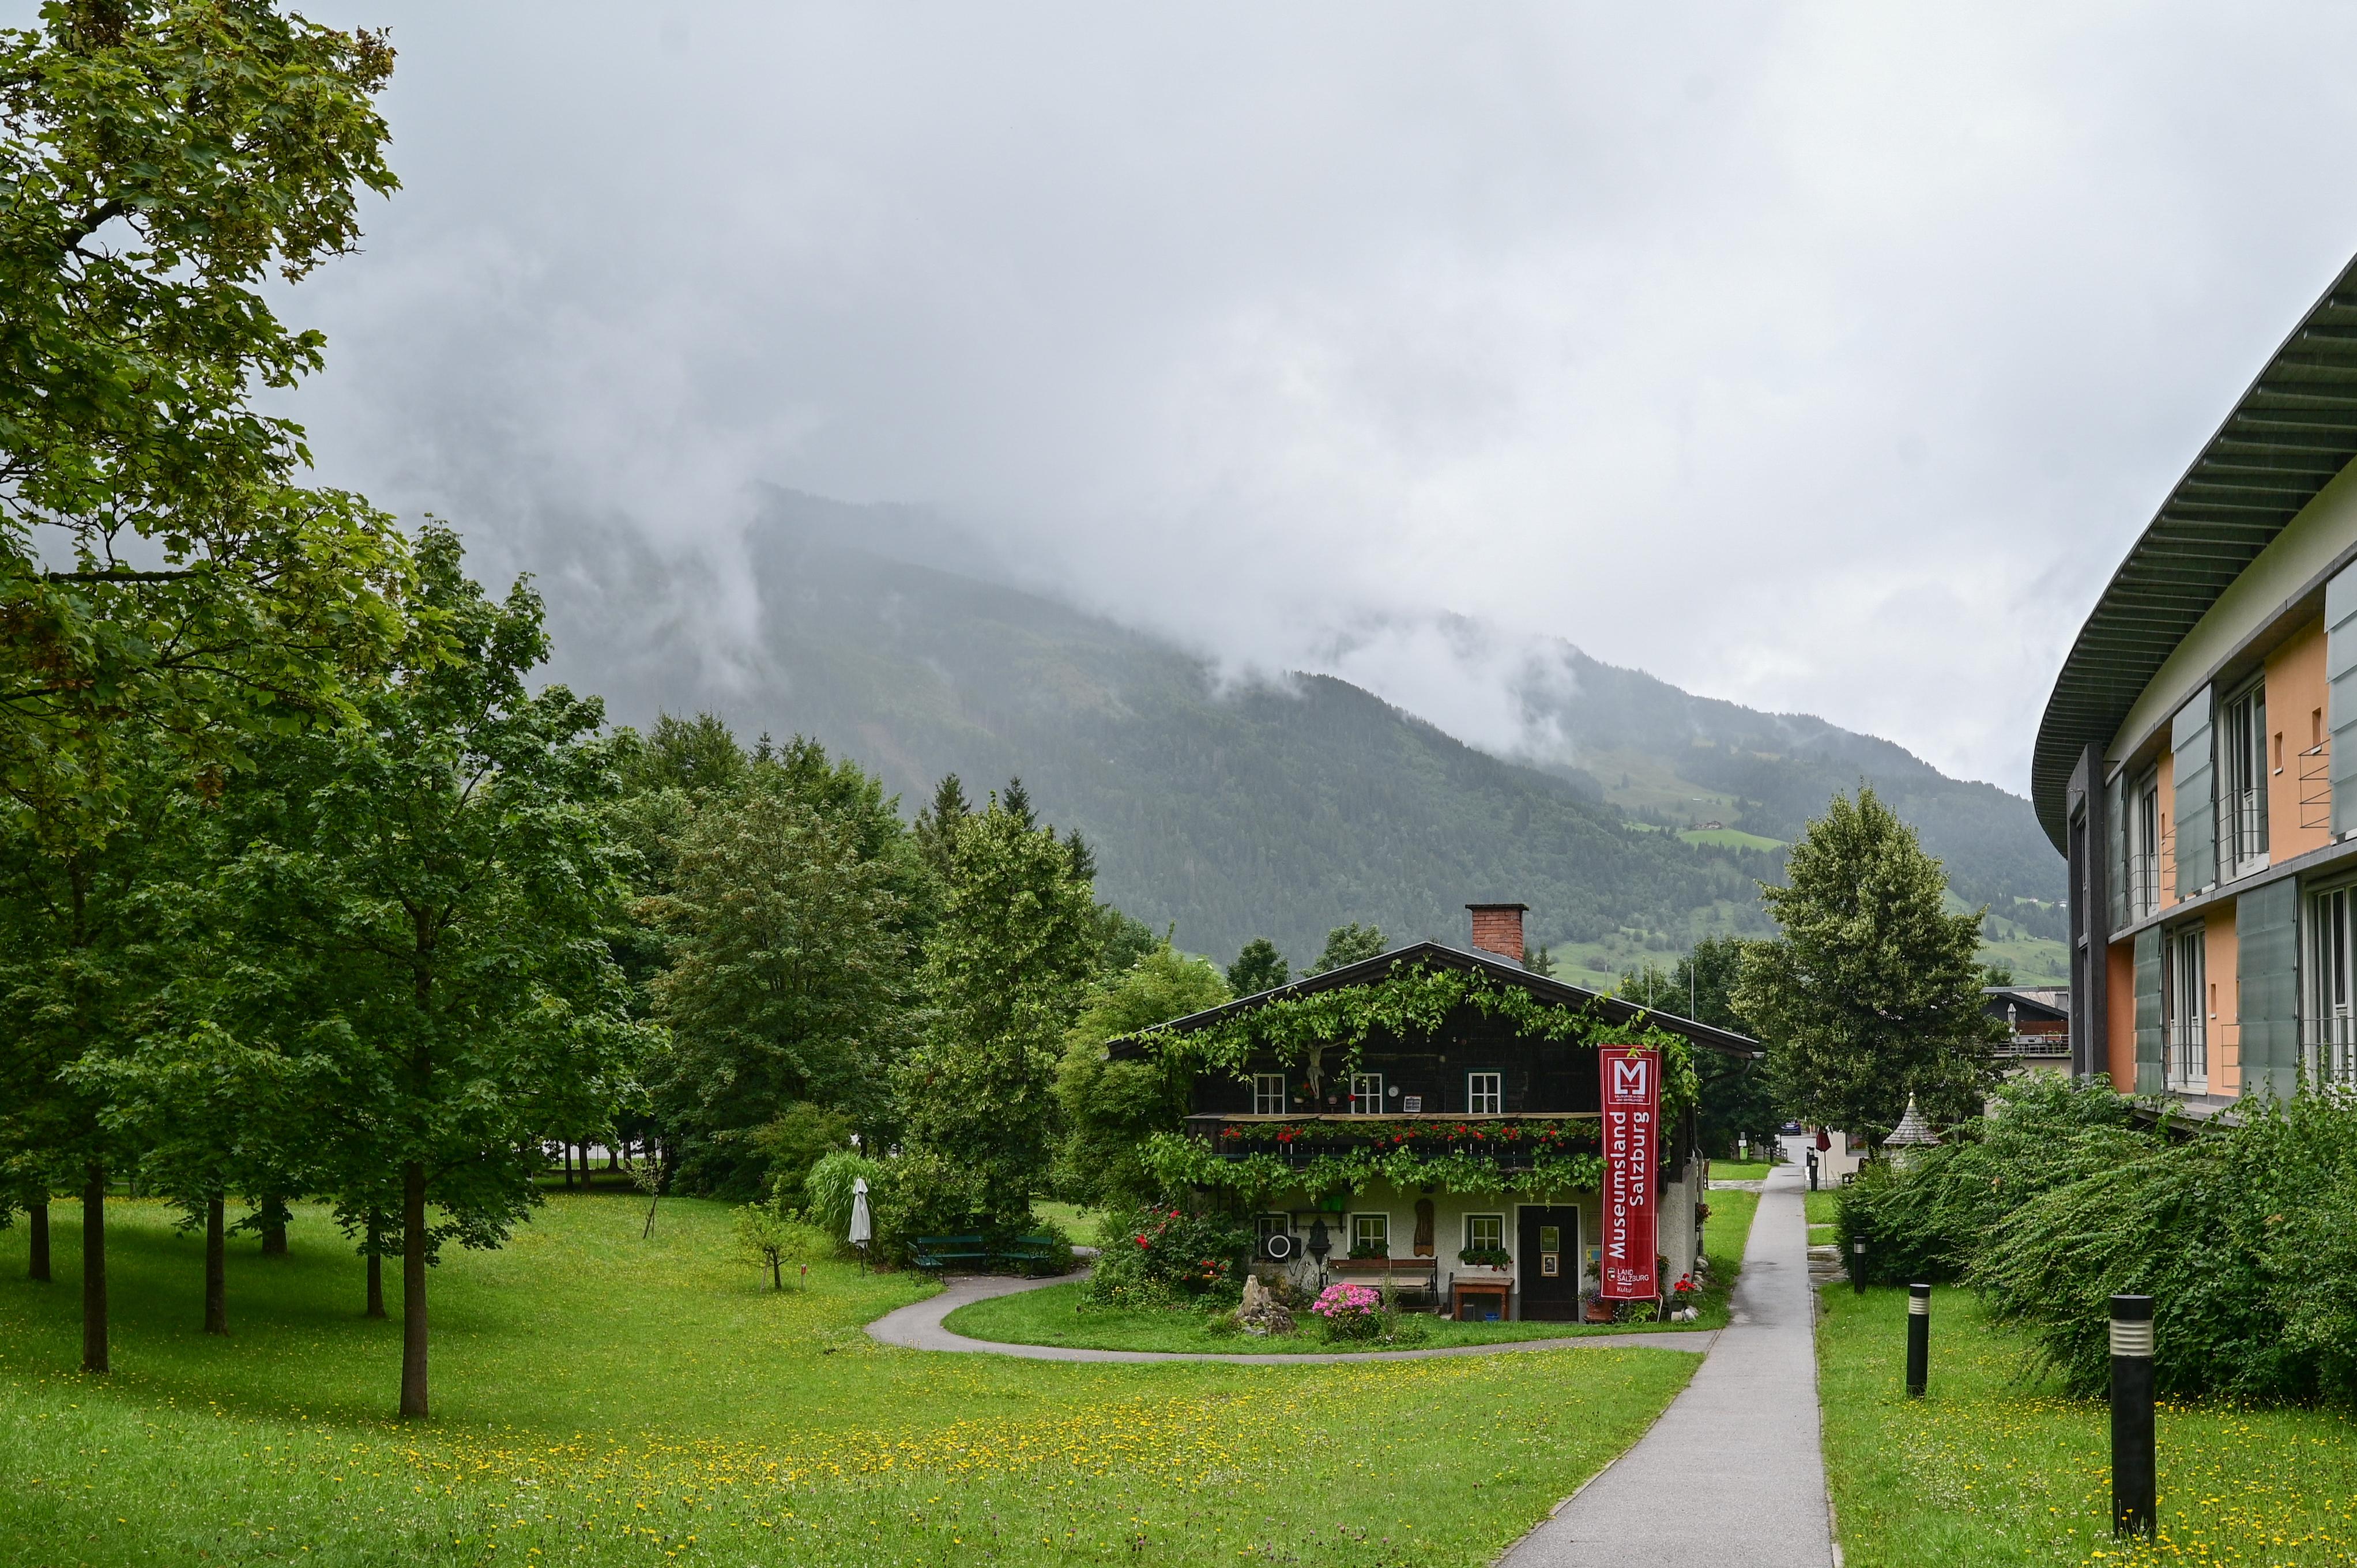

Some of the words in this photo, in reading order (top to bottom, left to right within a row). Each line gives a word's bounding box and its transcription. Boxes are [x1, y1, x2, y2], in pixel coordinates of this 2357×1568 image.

[1609, 1111, 1626, 1260] Museumsland
[1629, 1111, 1650, 1206] Salzburg
[1617, 1274, 1649, 1282] SALZBURG
